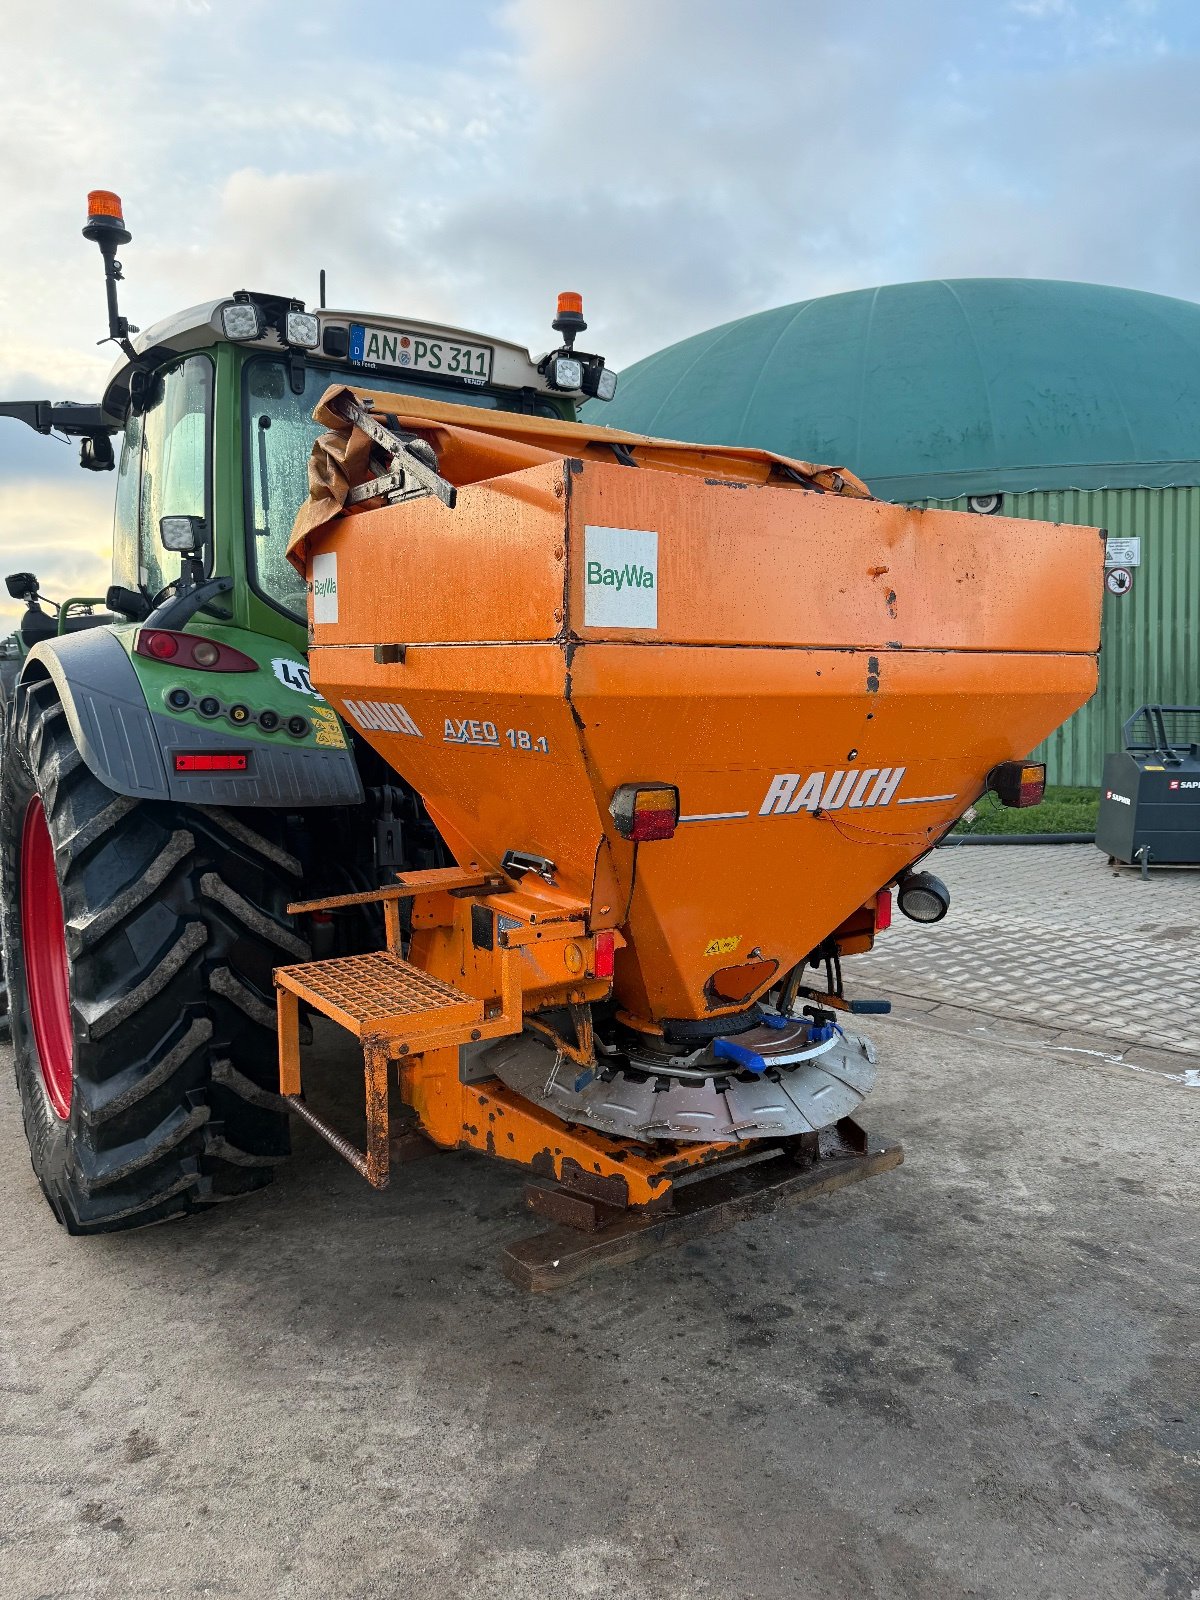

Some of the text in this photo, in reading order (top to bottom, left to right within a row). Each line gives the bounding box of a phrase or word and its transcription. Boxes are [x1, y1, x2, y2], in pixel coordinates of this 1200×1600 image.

[354, 333, 487, 377] D AN PS 311
[314, 577, 337, 597] BayWa
[587, 561, 654, 591] BayWa
[341, 699, 425, 738] RAUCH
[444, 718, 550, 754] AXEO 18.1
[758, 766, 907, 816] RAUCH
